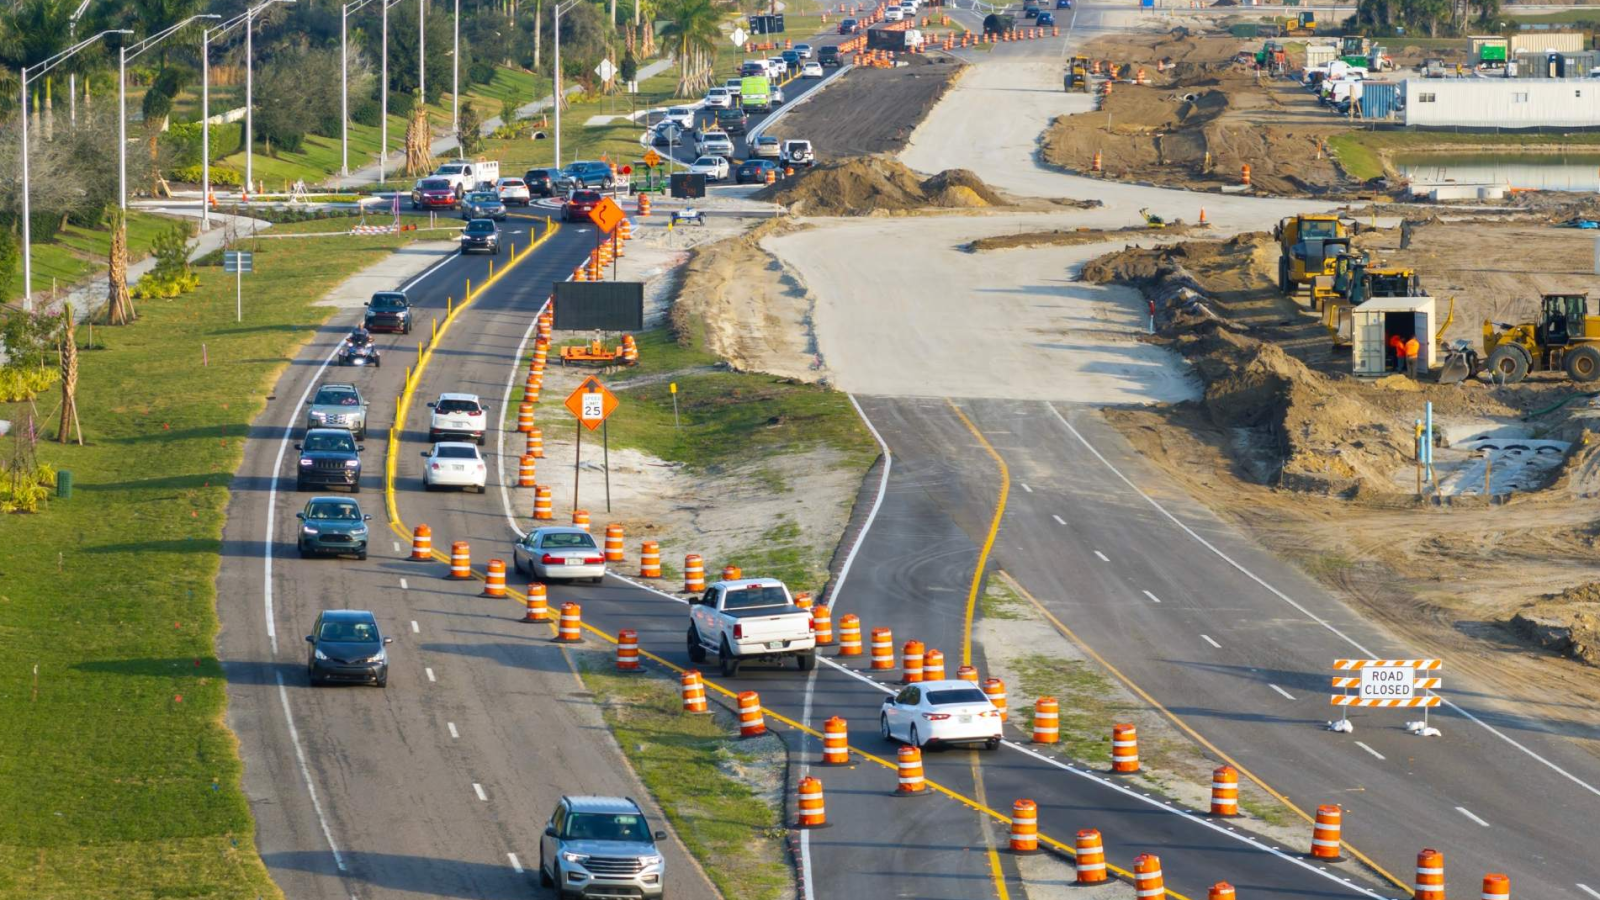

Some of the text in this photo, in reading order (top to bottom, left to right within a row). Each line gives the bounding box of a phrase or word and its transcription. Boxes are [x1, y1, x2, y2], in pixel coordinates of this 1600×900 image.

[585, 406, 601, 416] 25
[1372, 671, 1404, 681] ROAD
[1365, 685, 1410, 695] CLOSED
